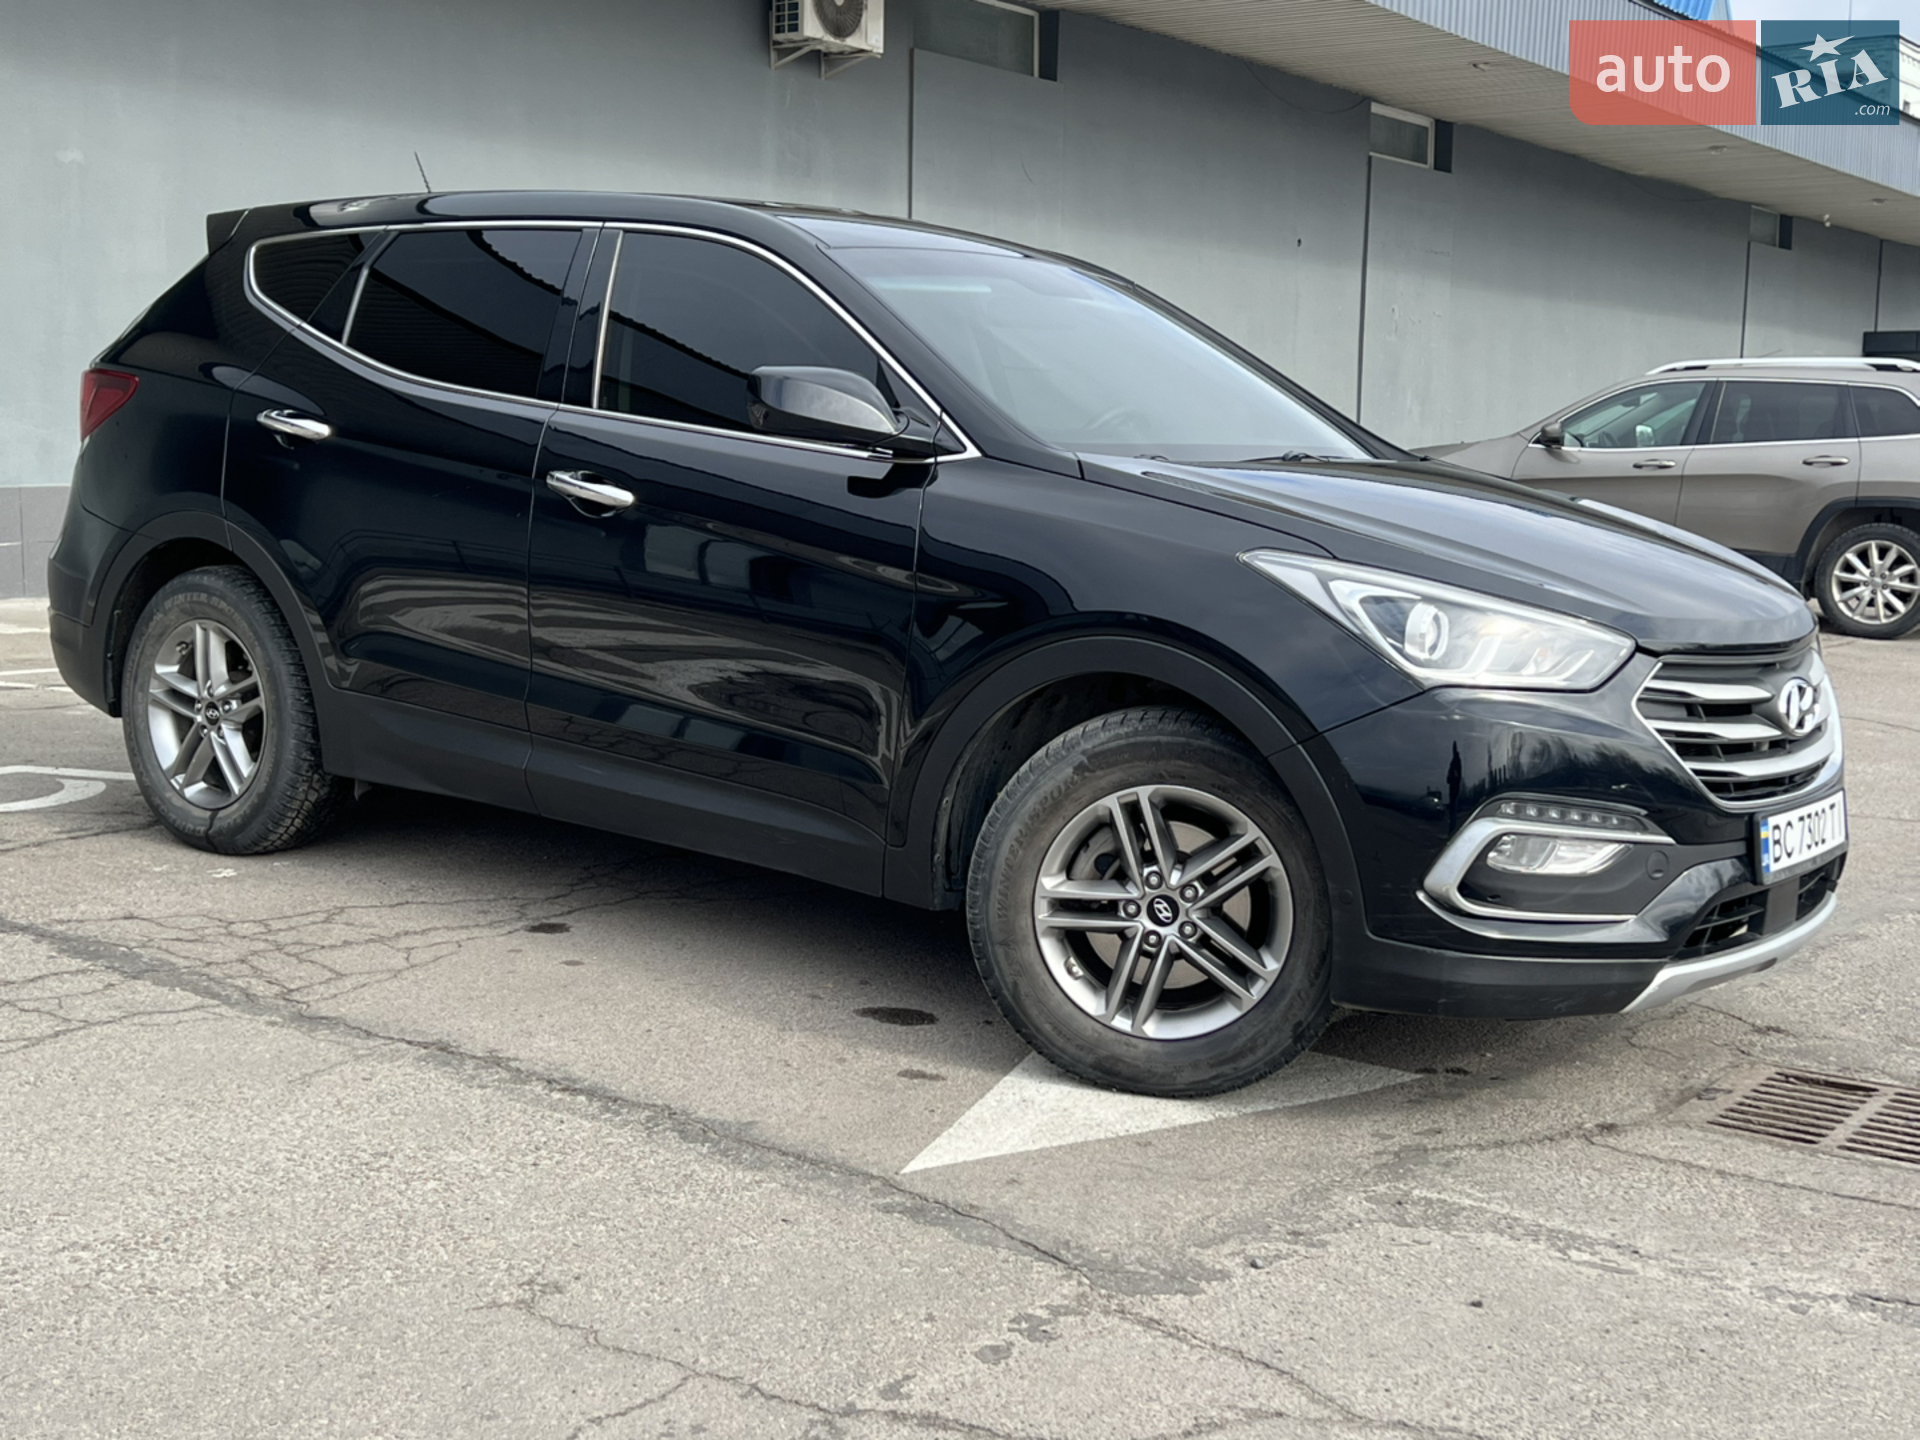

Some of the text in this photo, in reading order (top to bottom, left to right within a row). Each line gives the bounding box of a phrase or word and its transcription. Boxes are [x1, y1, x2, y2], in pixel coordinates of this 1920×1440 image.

[164, 591, 208, 610] WINTER
[1772, 820, 1794, 863] BC
[1798, 808, 1826, 855] 7302
